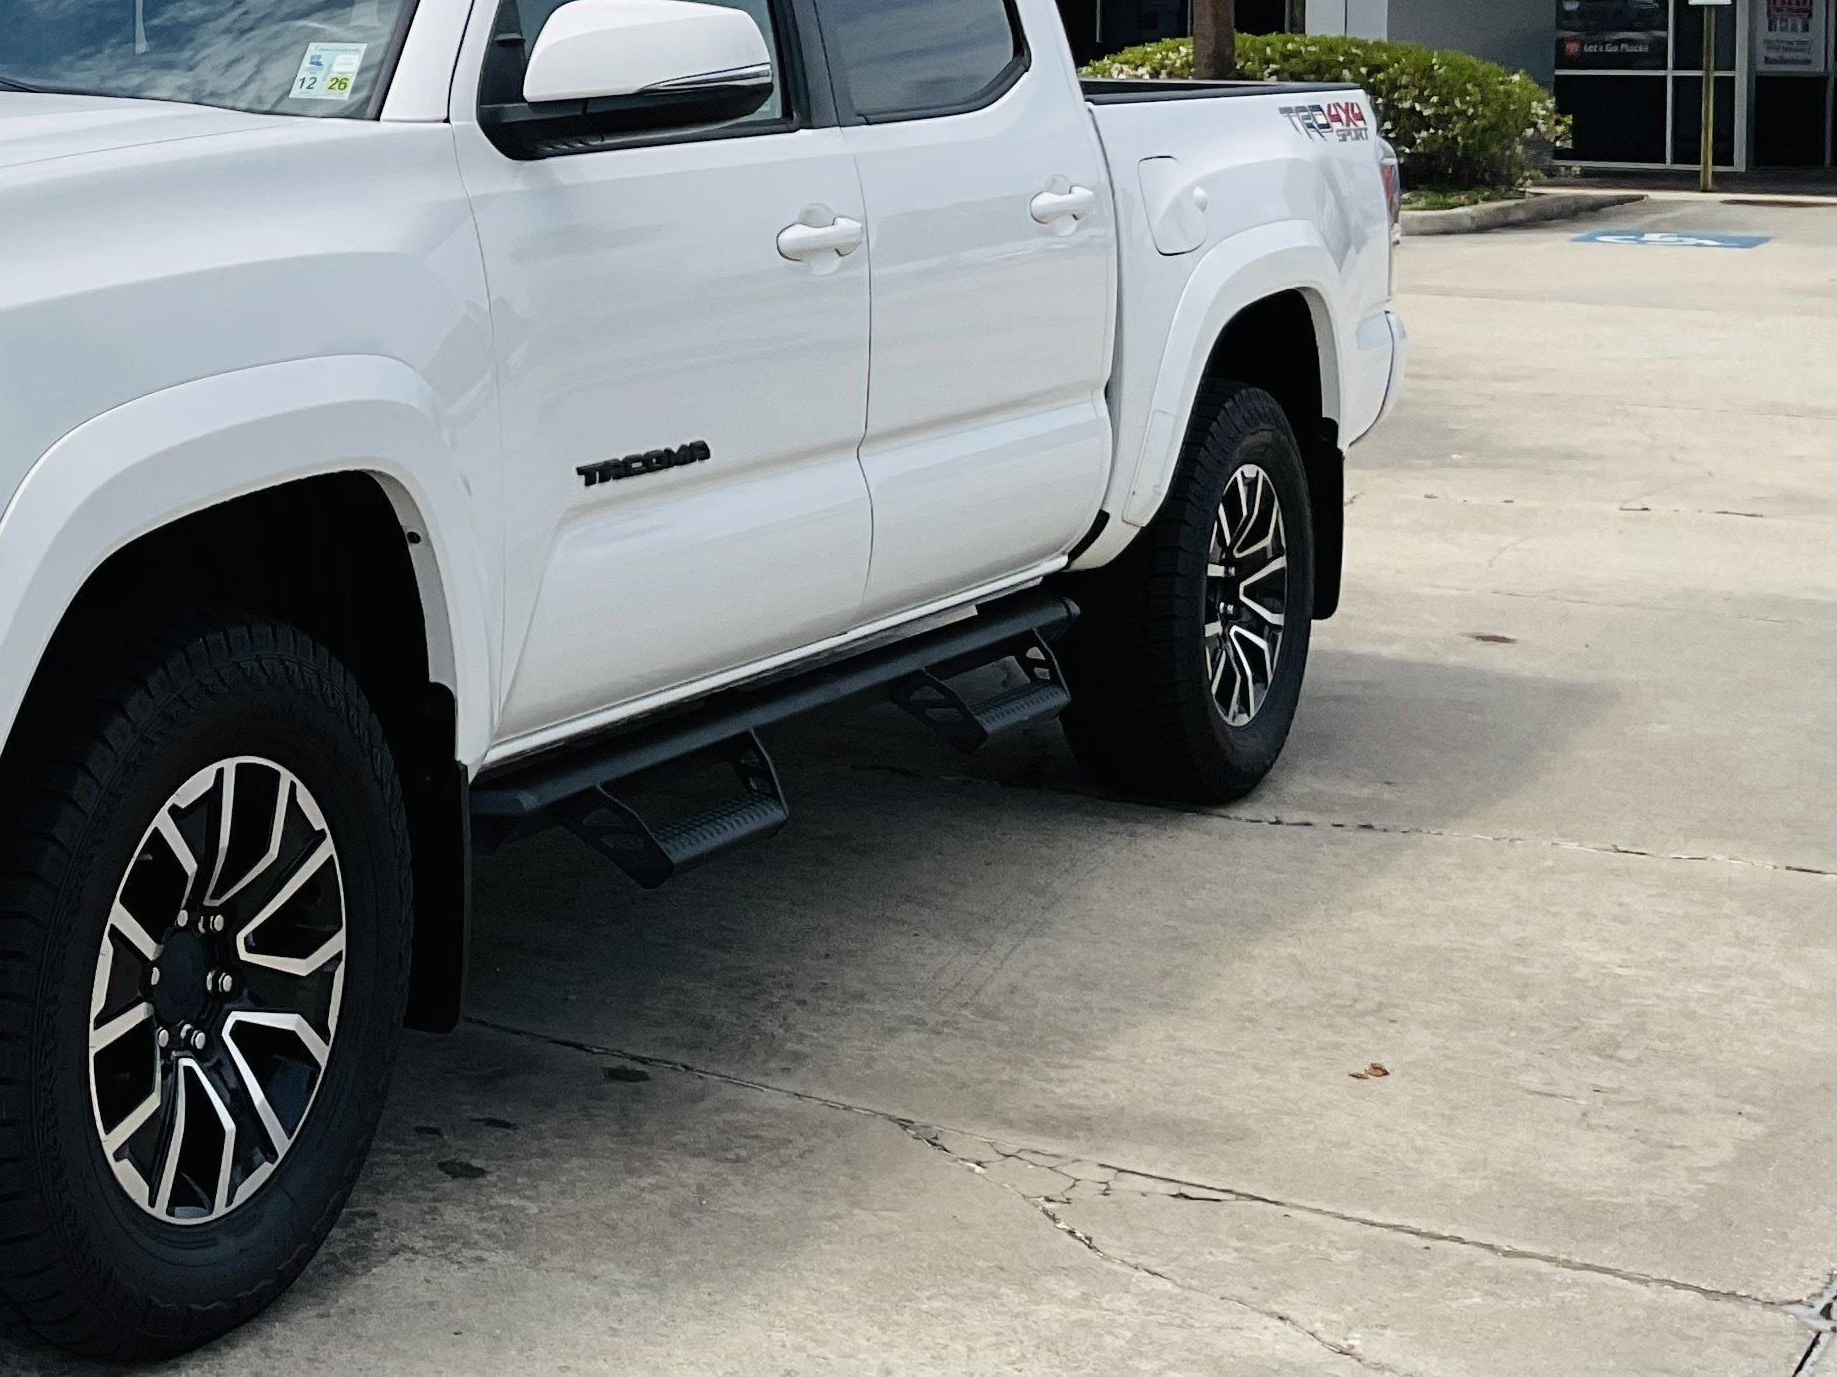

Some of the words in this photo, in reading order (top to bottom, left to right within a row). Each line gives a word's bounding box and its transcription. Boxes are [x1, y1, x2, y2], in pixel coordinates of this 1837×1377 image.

[299, 76, 318, 90] 12
[328, 77, 350, 91] 26
[1278, 104, 1333, 141] TRD
[1336, 127, 1369, 142] SPORT
[575, 439, 712, 487] TACOMA
